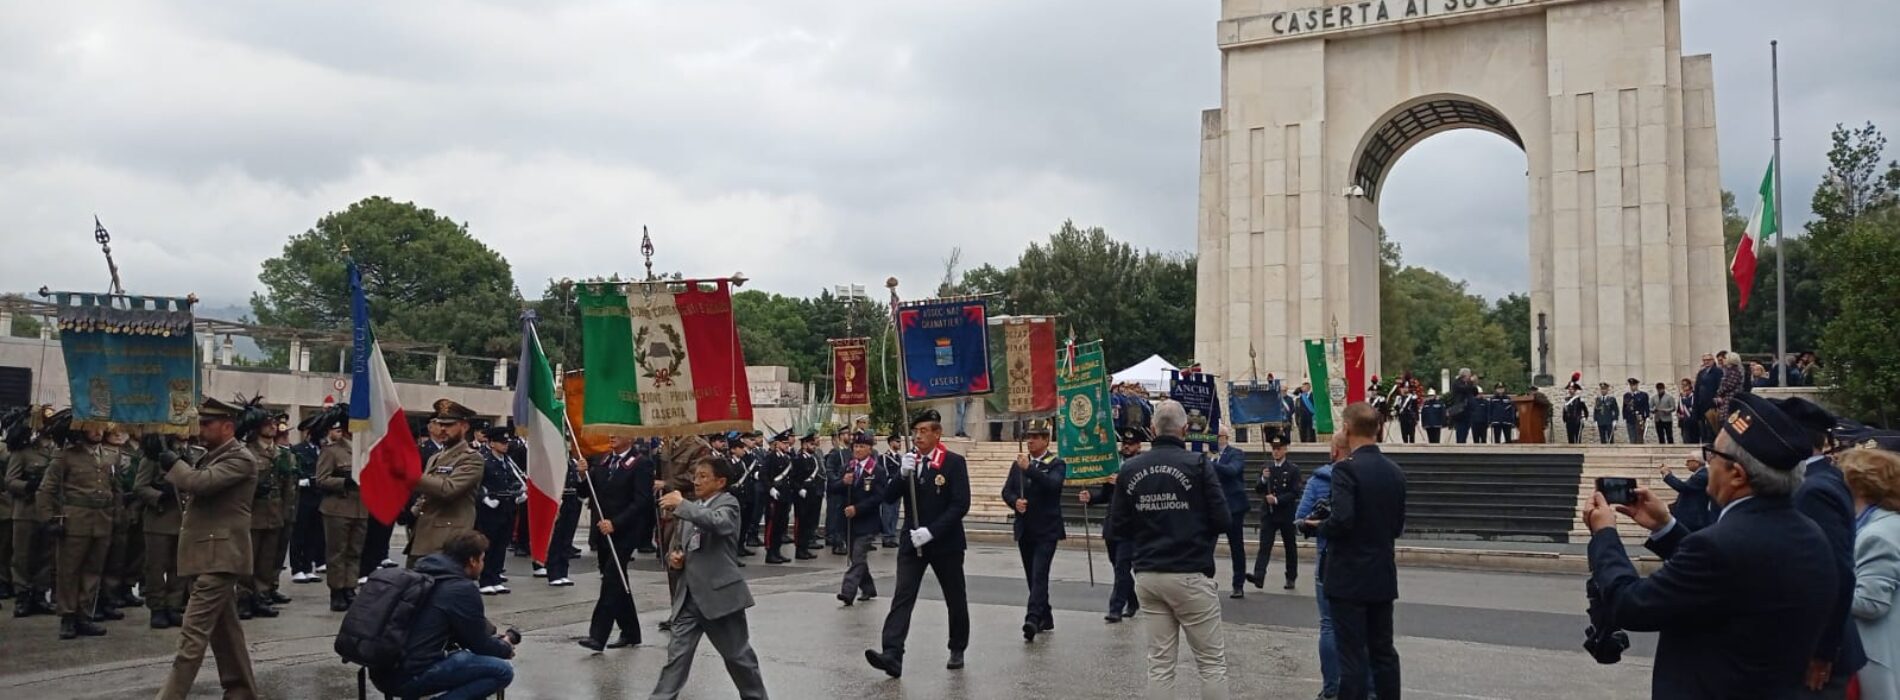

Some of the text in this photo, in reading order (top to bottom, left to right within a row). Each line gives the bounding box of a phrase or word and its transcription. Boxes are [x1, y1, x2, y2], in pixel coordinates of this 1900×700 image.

[1272, 0, 1389, 34] CASERTA
[1174, 384, 1210, 395] ANCRI
[1126, 465, 1193, 495] POLIZIA SCIENTIFICA
[1140, 493, 1178, 503] SQUADRA
